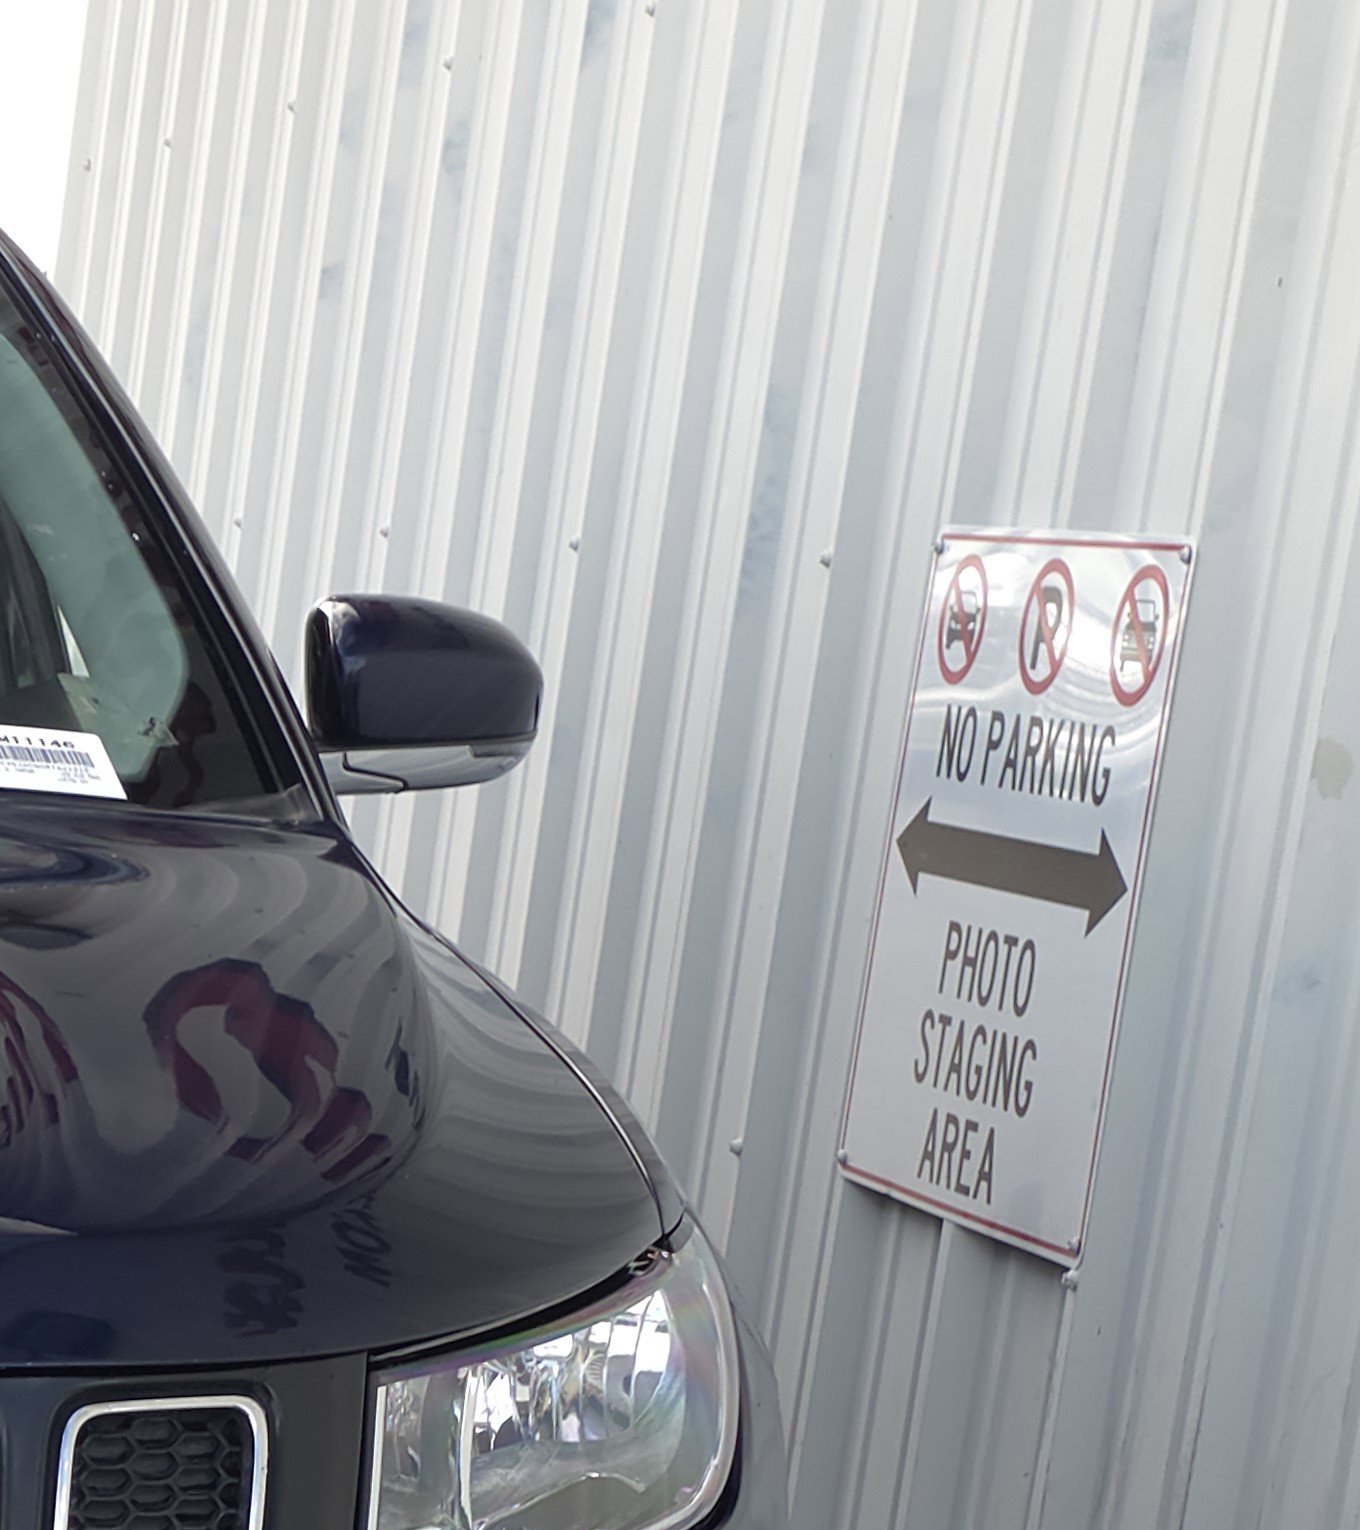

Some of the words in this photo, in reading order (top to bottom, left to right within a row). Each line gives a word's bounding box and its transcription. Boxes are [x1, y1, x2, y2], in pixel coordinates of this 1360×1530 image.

[935, 703, 978, 783] NO
[980, 708, 1116, 806] PARKING
[938, 919, 1037, 1018] PHOTO
[913, 1008, 1038, 1118] STAGING
[916, 1107, 997, 1205] AREA
